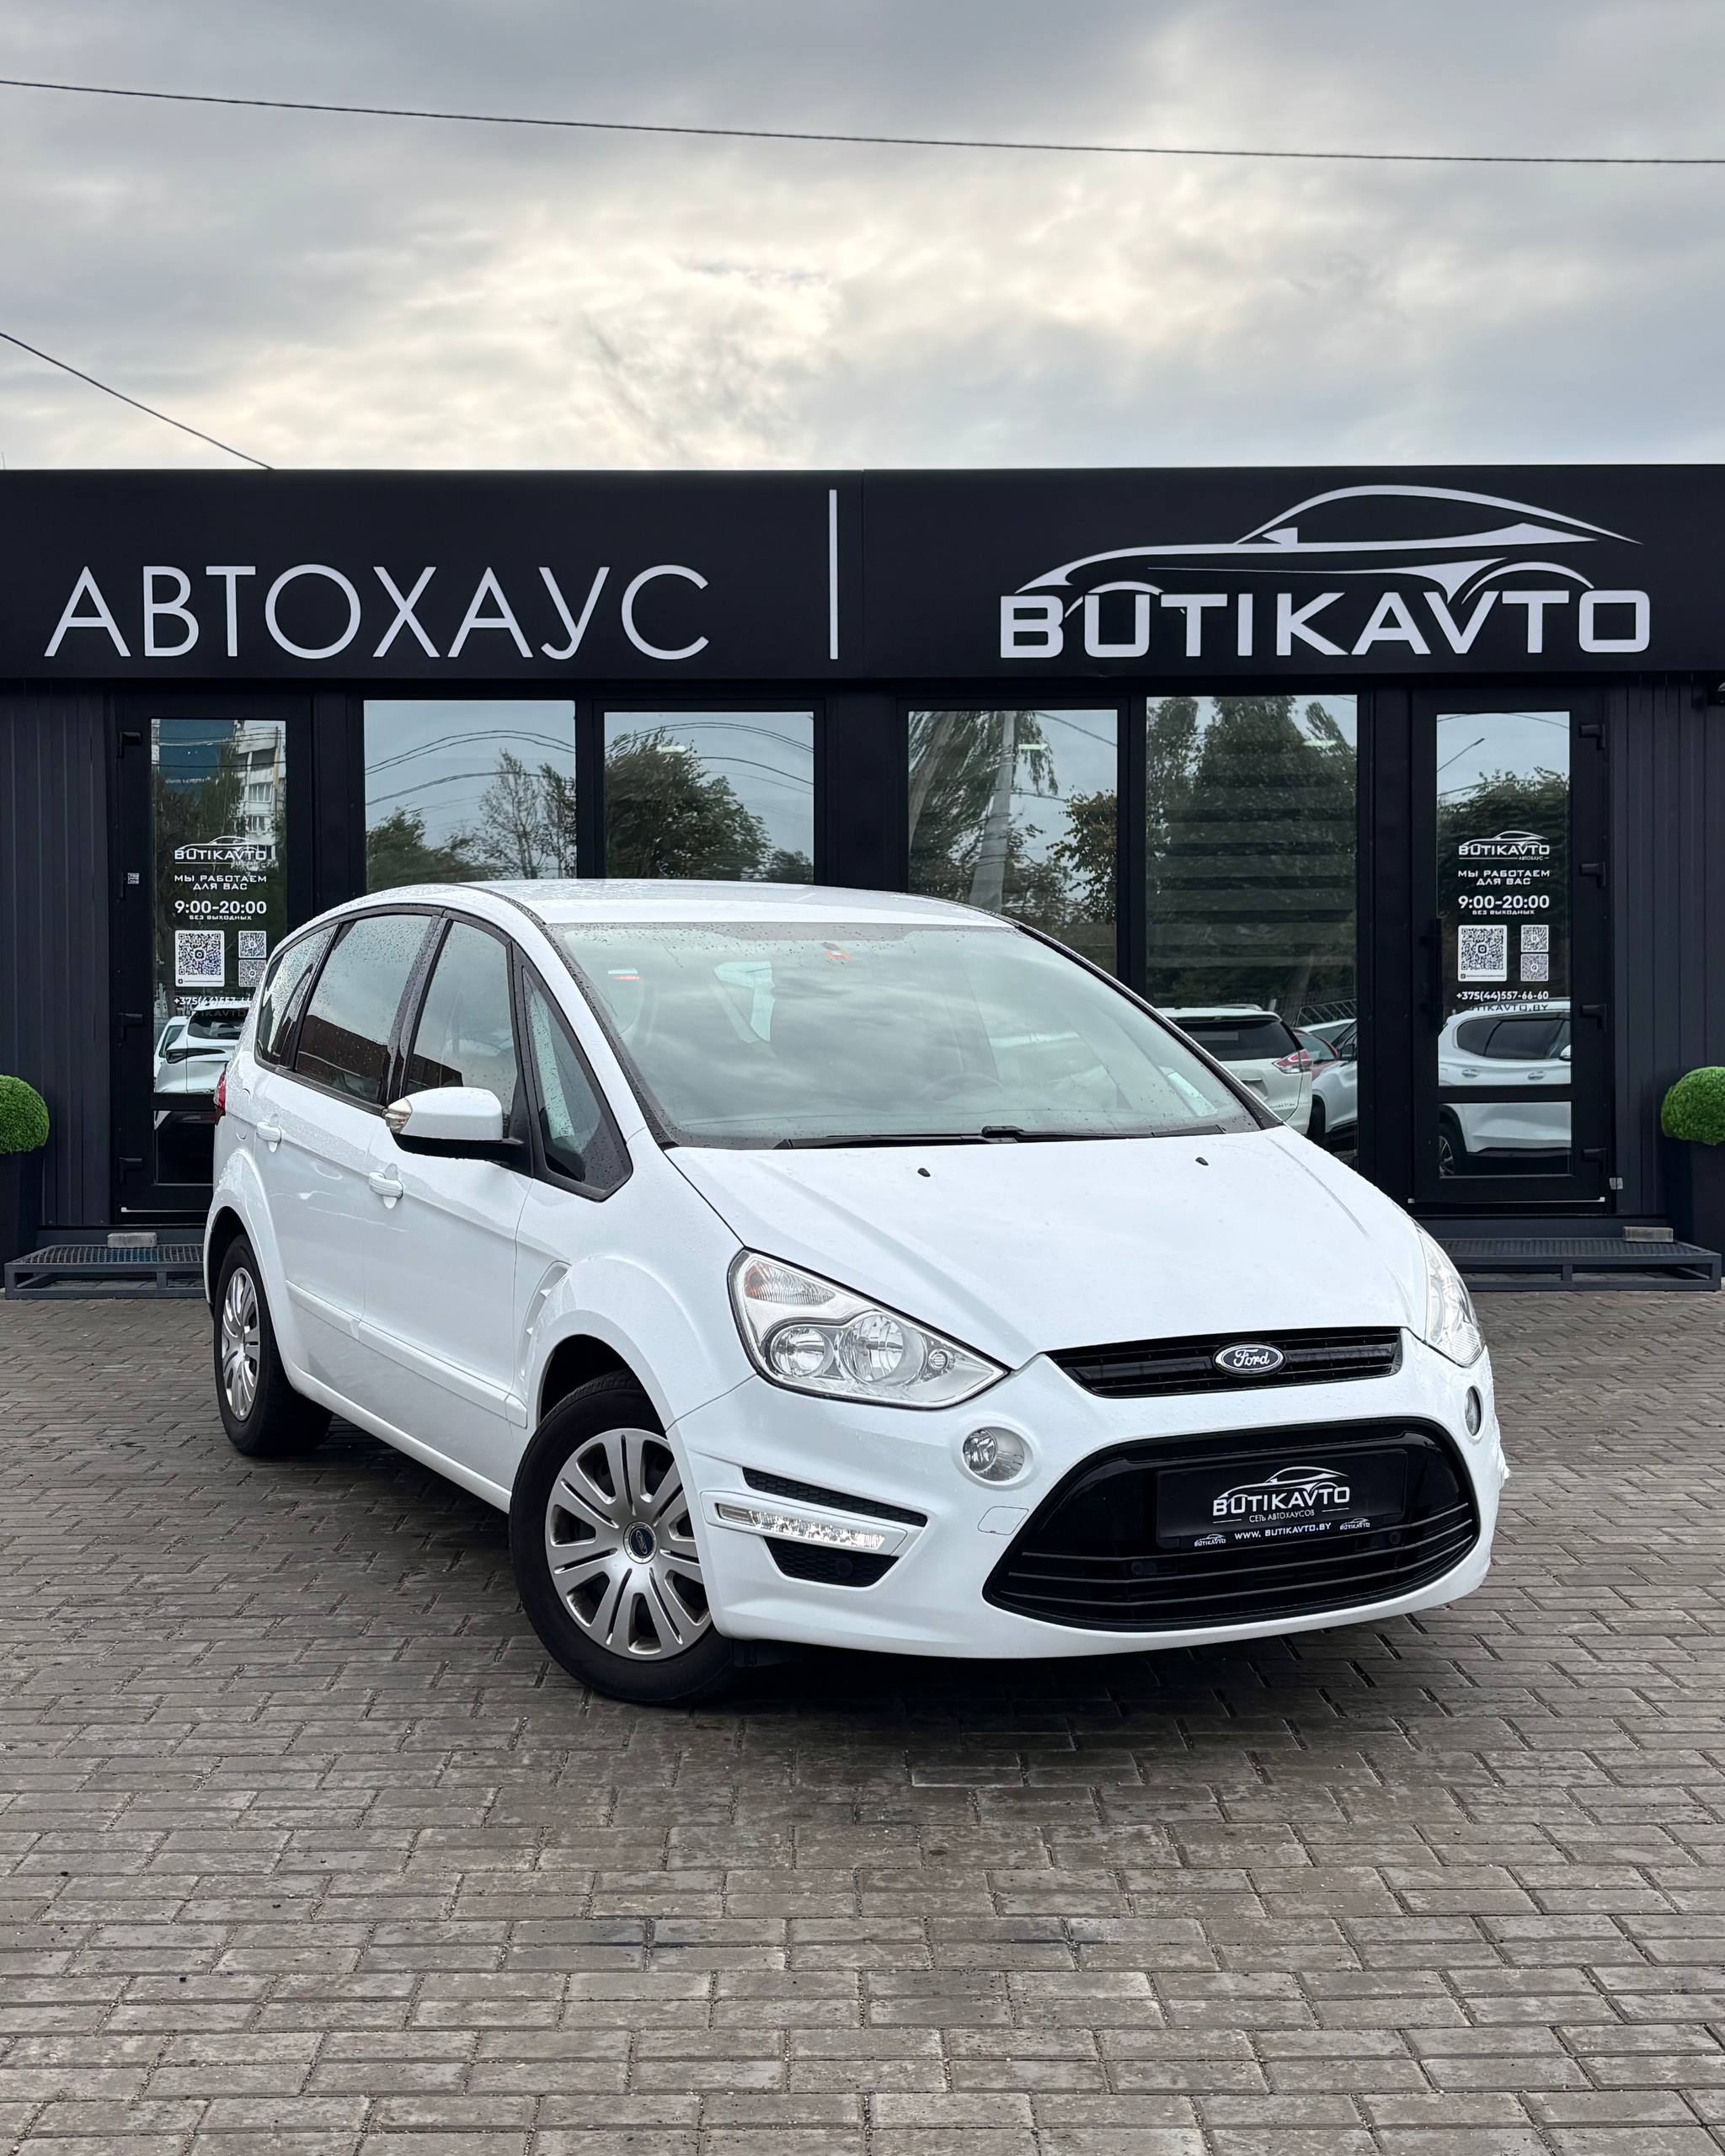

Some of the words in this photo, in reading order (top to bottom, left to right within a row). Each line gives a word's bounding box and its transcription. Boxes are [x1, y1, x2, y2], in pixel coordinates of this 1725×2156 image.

[44, 563, 709, 659] АВТОХАУС
[1000, 590, 1651, 659] BUTIKAVTO
[174, 849, 267, 860] BUTIKAVTO
[1458, 845, 1550, 856] BUTIKAVTO
[174, 874, 195, 883] МЫ
[200, 874, 267, 883] РАБОТАЕМ
[174, 899, 267, 914] 9:00-20:00
[1458, 895, 1550, 909] 9:00-20:00
[1456, 990, 1549, 1001] +375(44)557-66-60
[1233, 1348, 1270, 1368] Ford
[1213, 1486, 1350, 1516] BUTIKAVTO
[1249, 1514, 1267, 1523] СЕТЬ
[1268, 1509, 1315, 1522] АВТОХАУСОВ
[1235, 1531, 1262, 1540] WWW.
[1264, 1522, 1332, 1537] BUTIKAVTO.BY
